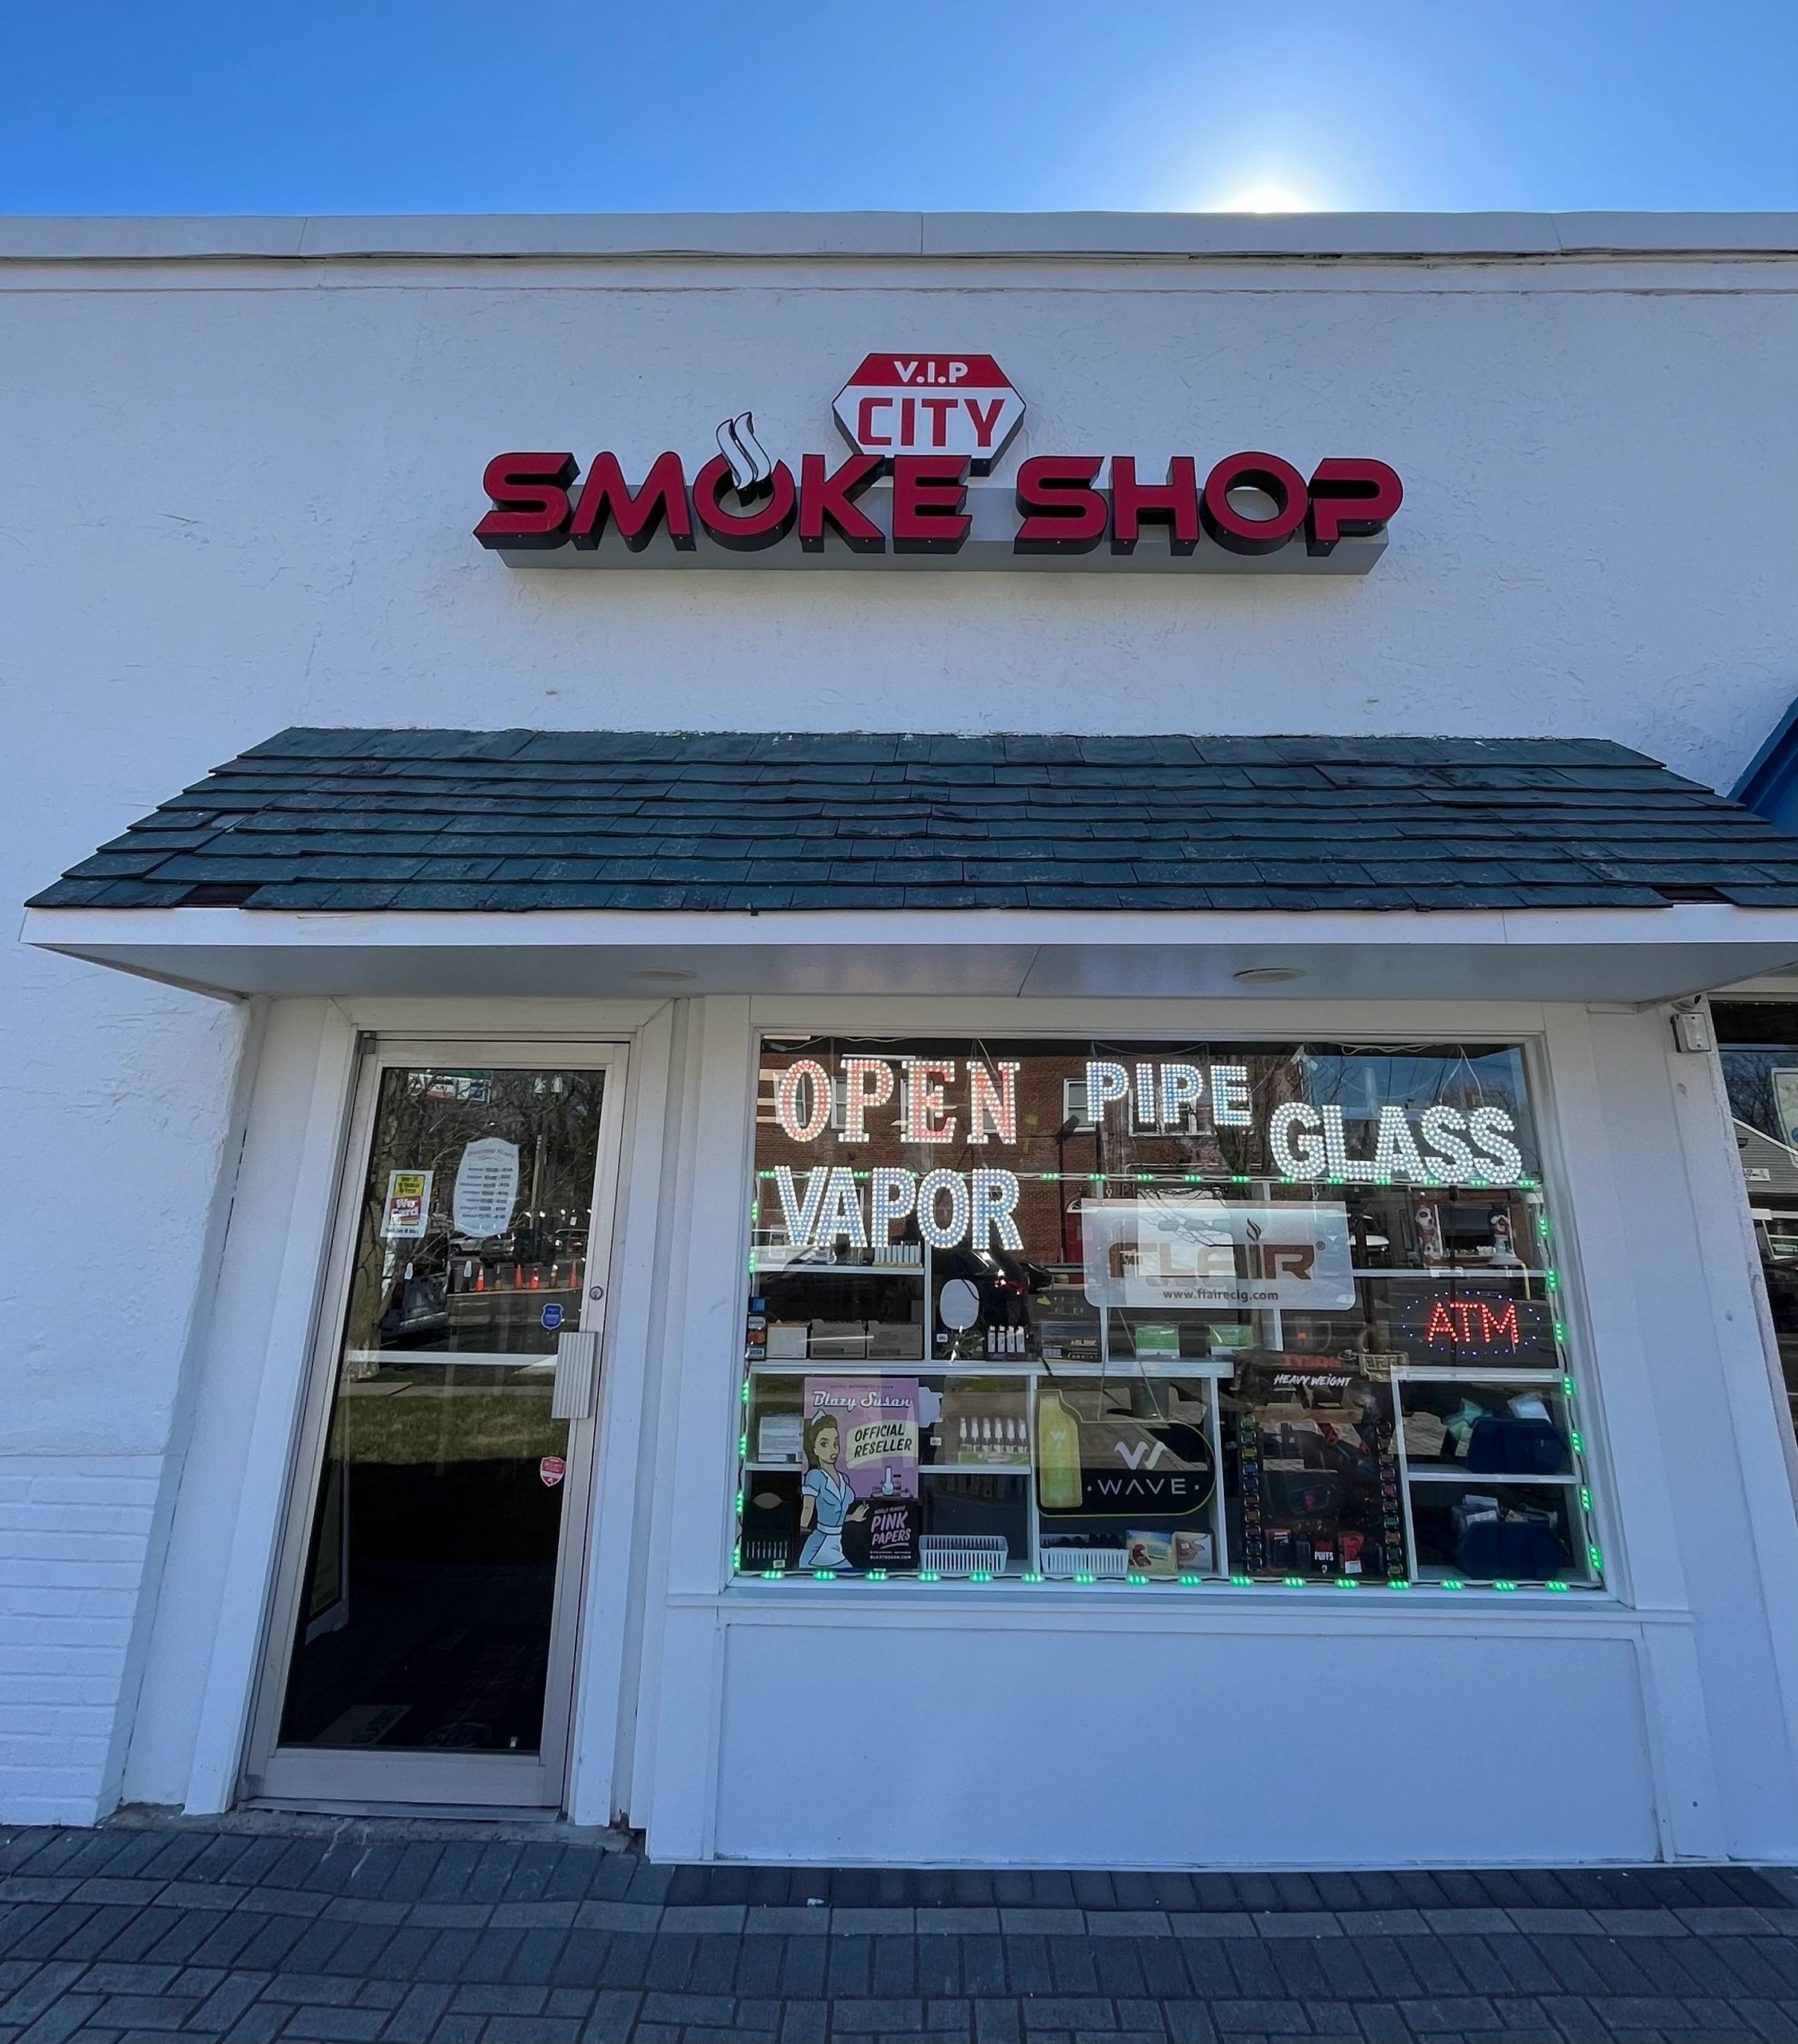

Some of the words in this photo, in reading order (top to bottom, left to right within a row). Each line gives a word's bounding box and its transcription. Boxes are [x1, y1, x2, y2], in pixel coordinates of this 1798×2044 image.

[893, 361, 968, 383] V.I.P
[857, 397, 1005, 447] CITY
[473, 450, 972, 551] SMOKE
[1014, 451, 1403, 554] SHOP
[778, 1059, 1020, 1143] OPEN
[1086, 1061, 1251, 1126] PIPE
[1269, 1101, 1522, 1184] GLASS
[774, 1165, 1024, 1250] VAPOR
[1163, 1289, 1278, 1302] www.flairecig.com
[1427, 1301, 1520, 1345] ATM
[1273, 1373, 1310, 1386] HEAVY
[813, 1390, 857, 1412] Blazy
[861, 1391, 912, 1408] Susan
[854, 1424, 905, 1442] OFFICIAL
[854, 1438, 913, 1458] RESELLER
[1098, 1478, 1186, 1495] WAVE
[871, 1511, 909, 1533] PINK
[872, 1528, 911, 1546] PAPERS
